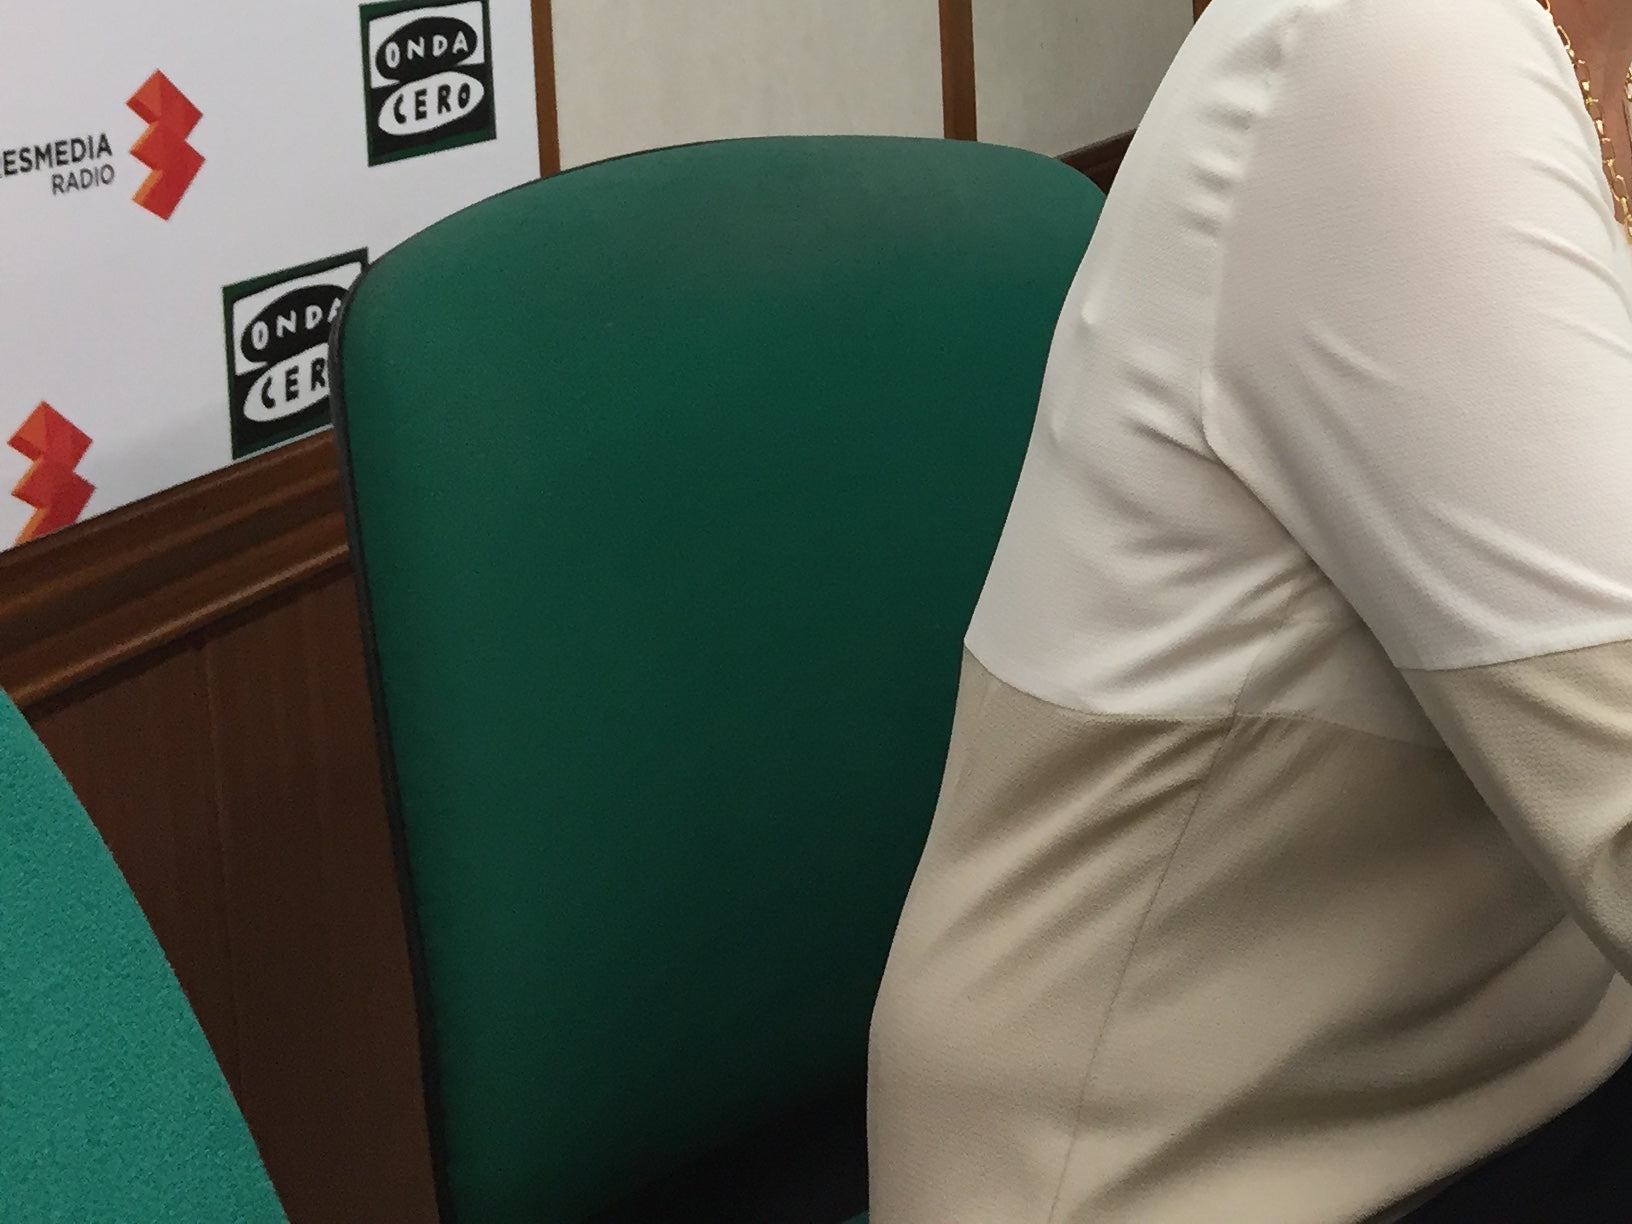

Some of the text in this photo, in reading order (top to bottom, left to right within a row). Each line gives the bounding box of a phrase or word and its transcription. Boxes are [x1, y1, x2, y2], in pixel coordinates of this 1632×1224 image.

[383, 30, 470, 69] ONDA
[392, 81, 471, 125] CERO
[0, 132, 113, 178] ESMEDIA
[51, 163, 116, 196] RADIO
[260, 357, 326, 410] CER
